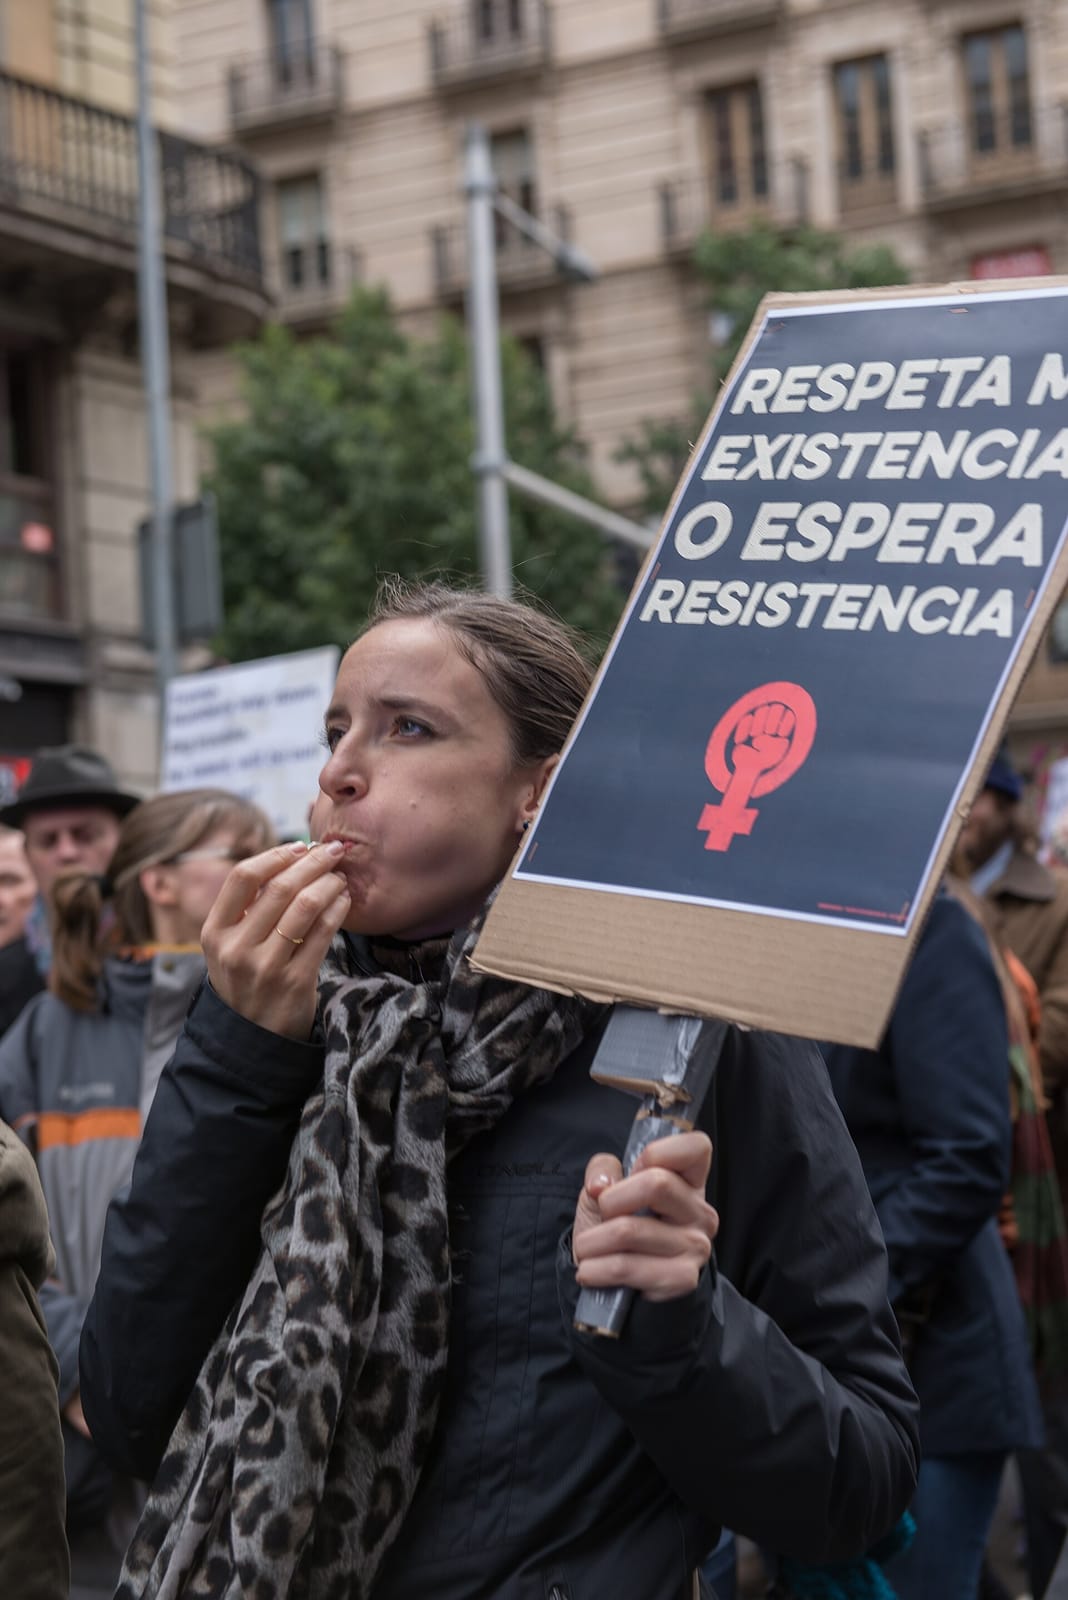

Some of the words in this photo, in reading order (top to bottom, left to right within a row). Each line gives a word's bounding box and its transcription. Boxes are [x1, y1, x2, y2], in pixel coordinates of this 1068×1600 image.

[730, 355, 1011, 414] RESPETA
[701, 428, 1068, 481] EXISTENCIA
[674, 501, 733, 560] O
[740, 501, 1043, 567] ESPERA
[639, 578, 1013, 638] RESISTENCIA
